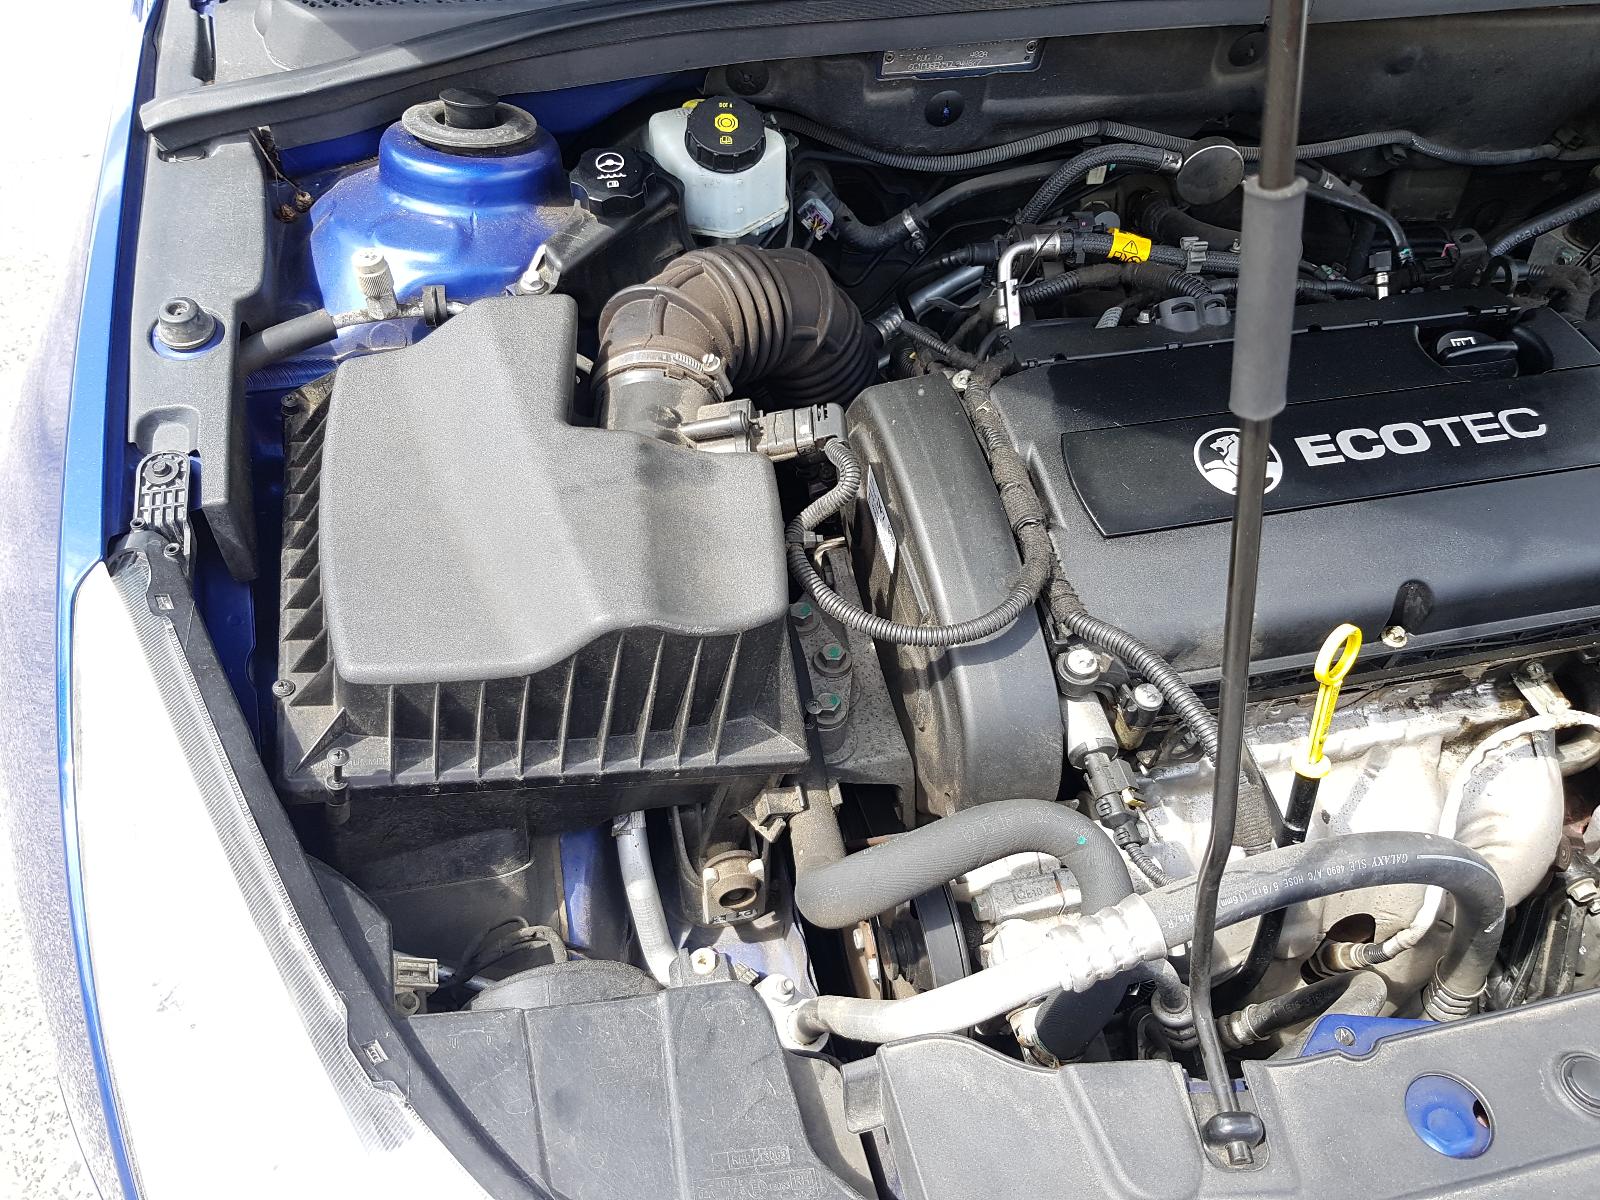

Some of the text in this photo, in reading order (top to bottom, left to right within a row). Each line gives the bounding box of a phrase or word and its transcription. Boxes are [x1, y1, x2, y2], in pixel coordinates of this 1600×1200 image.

[1294, 408, 1547, 467] ECOTEC
[1350, 858, 1367, 872] SLE
[1371, 852, 1408, 867] GALAXY
[1307, 868, 1323, 882] A/C
[1327, 864, 1345, 877] 4890
[1282, 874, 1304, 888] HOSE
